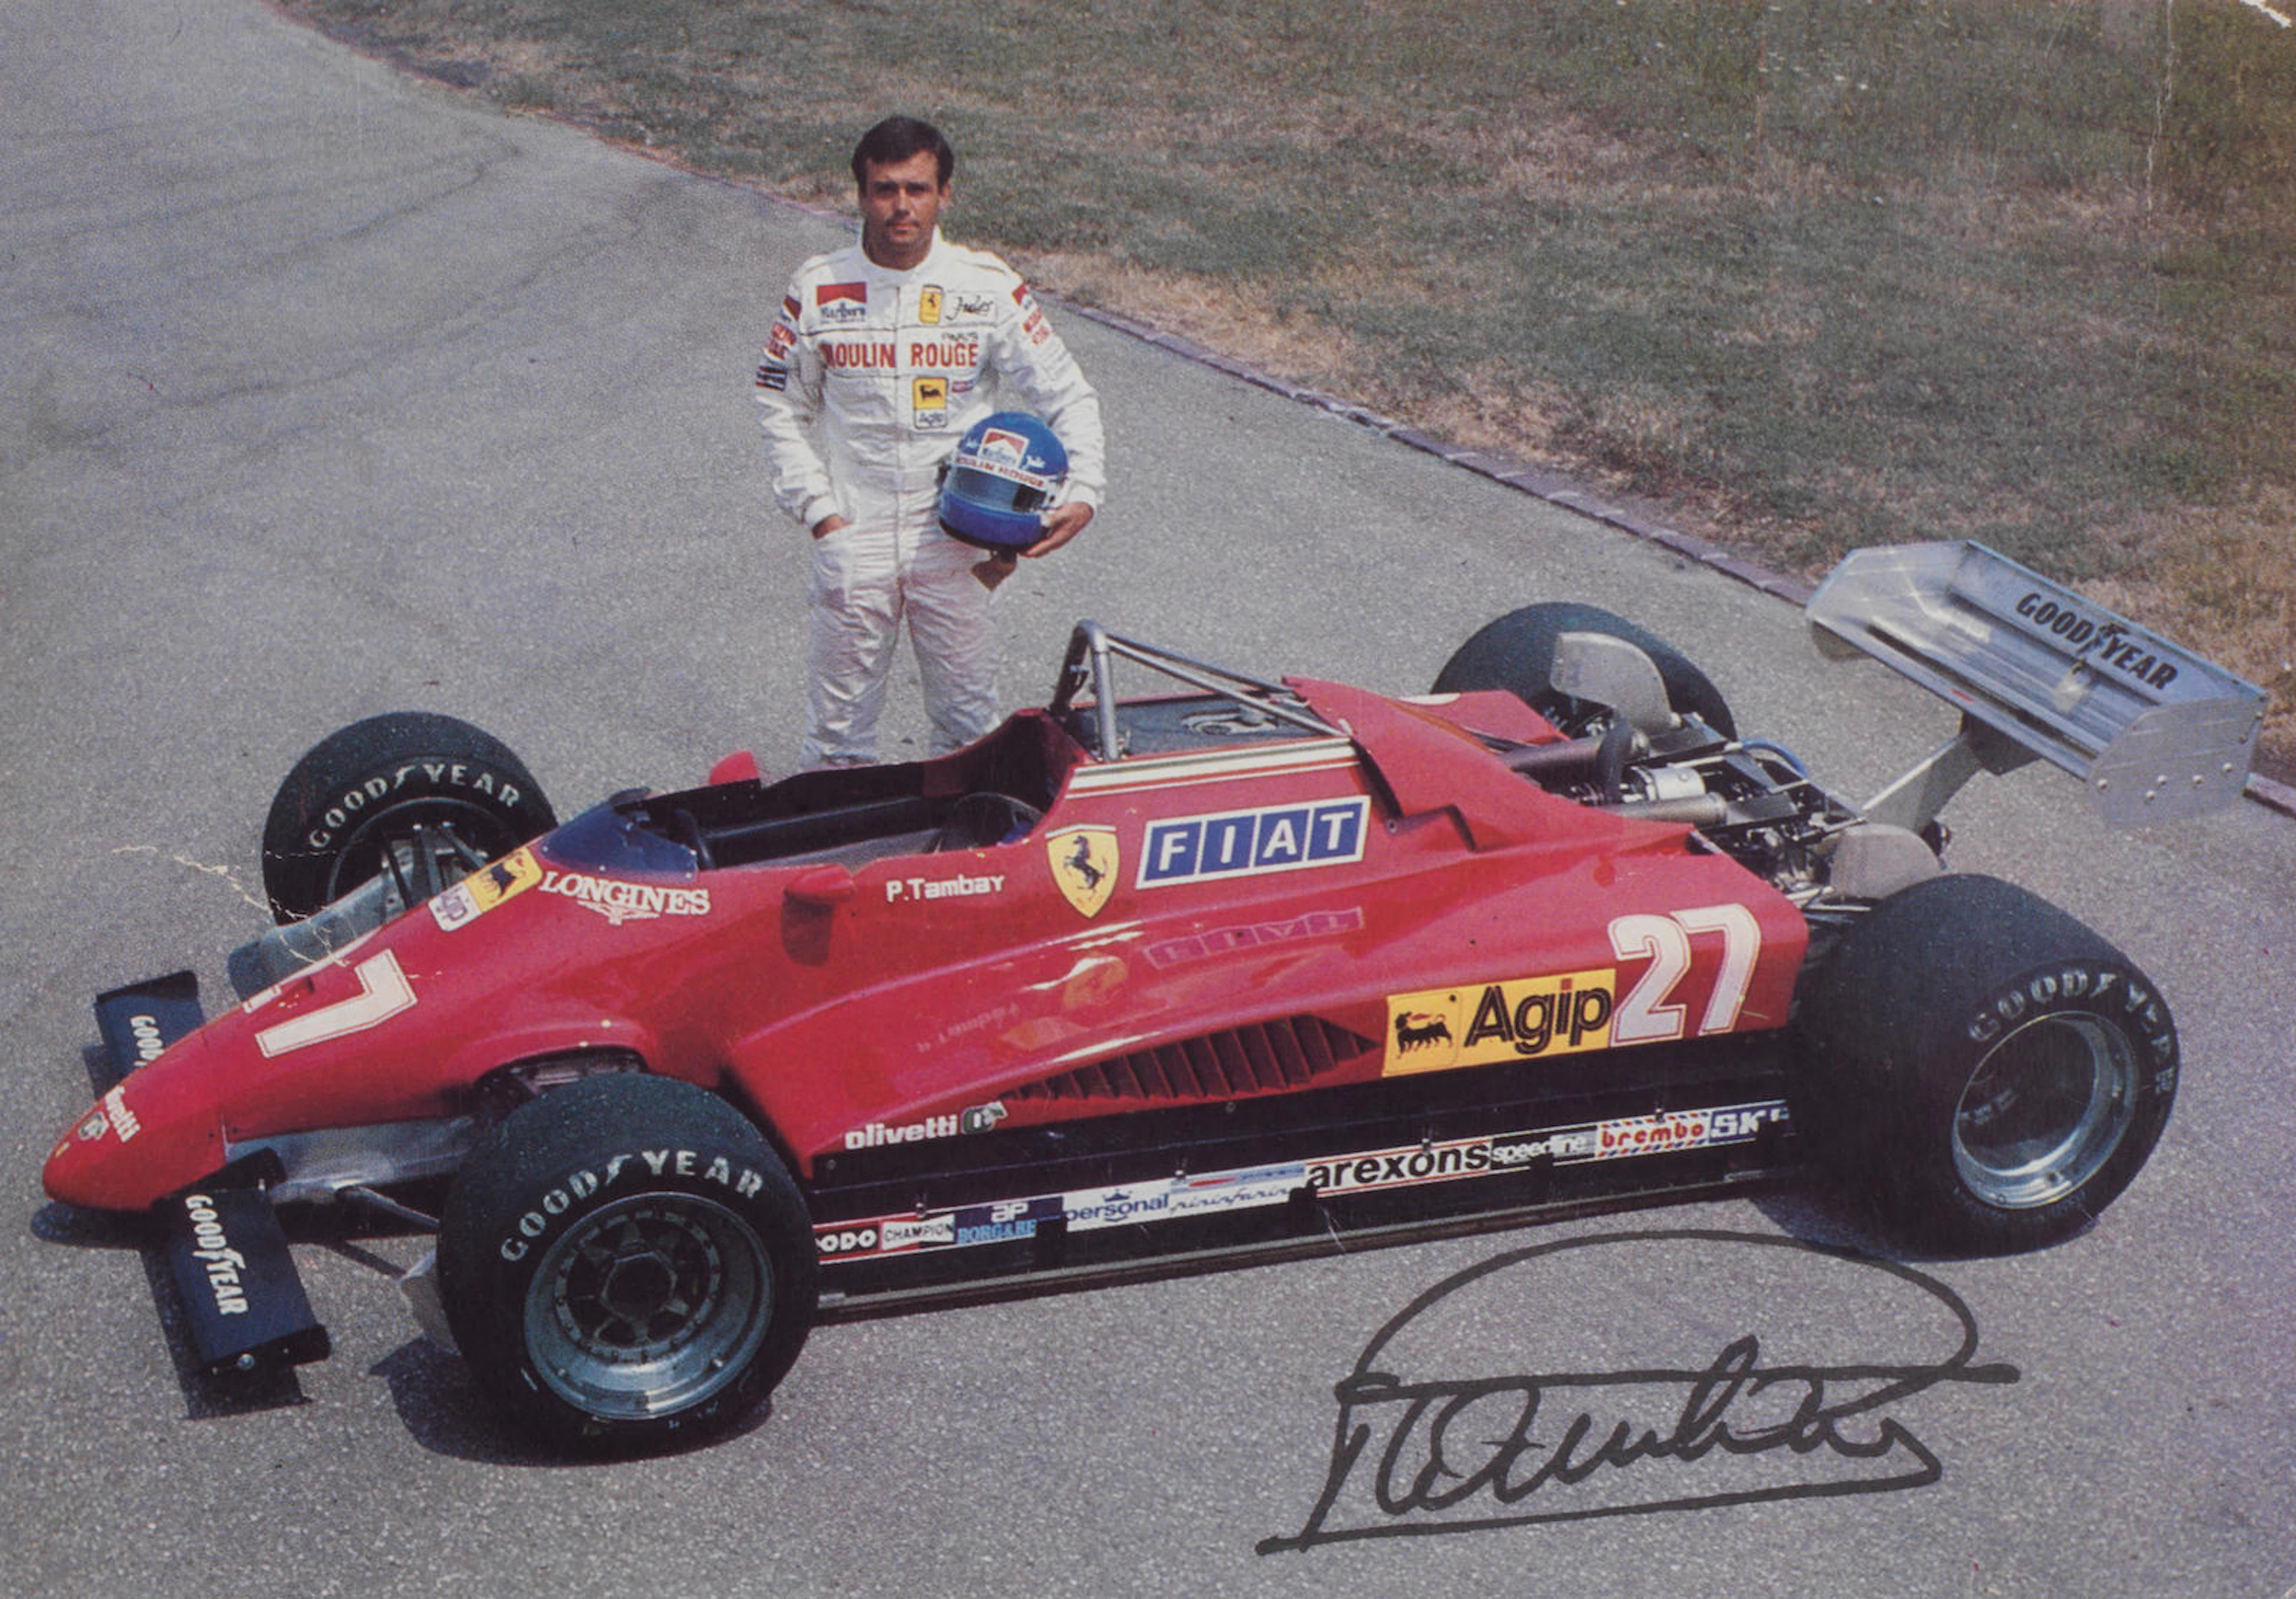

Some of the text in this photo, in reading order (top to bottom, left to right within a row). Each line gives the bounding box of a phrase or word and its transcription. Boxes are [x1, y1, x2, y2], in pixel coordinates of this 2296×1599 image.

[910, 343, 979, 367] ROUGE
[2016, 593, 2179, 691] GOODYEAR
[309, 762, 520, 849] GOODYEAR
[1159, 811, 1354, 872] FIAT
[539, 871, 712, 916] LONGINES
[1607, 903, 1761, 1048] 27
[1464, 978, 1612, 1055] Agip
[130, 1015, 166, 1067] GOOD
[845, 1114, 958, 1150] olivetti
[1492, 1134, 1587, 1163] speedline
[1601, 1122, 1704, 1148] brembo
[1307, 1143, 1490, 1188] arexons
[500, 1149, 764, 1262] GOODYEAR
[1065, 1193, 1169, 1222] personal
[185, 1195, 249, 1316] GOODYEAR
[815, 1221, 954, 1253] ODO CHAMPION
